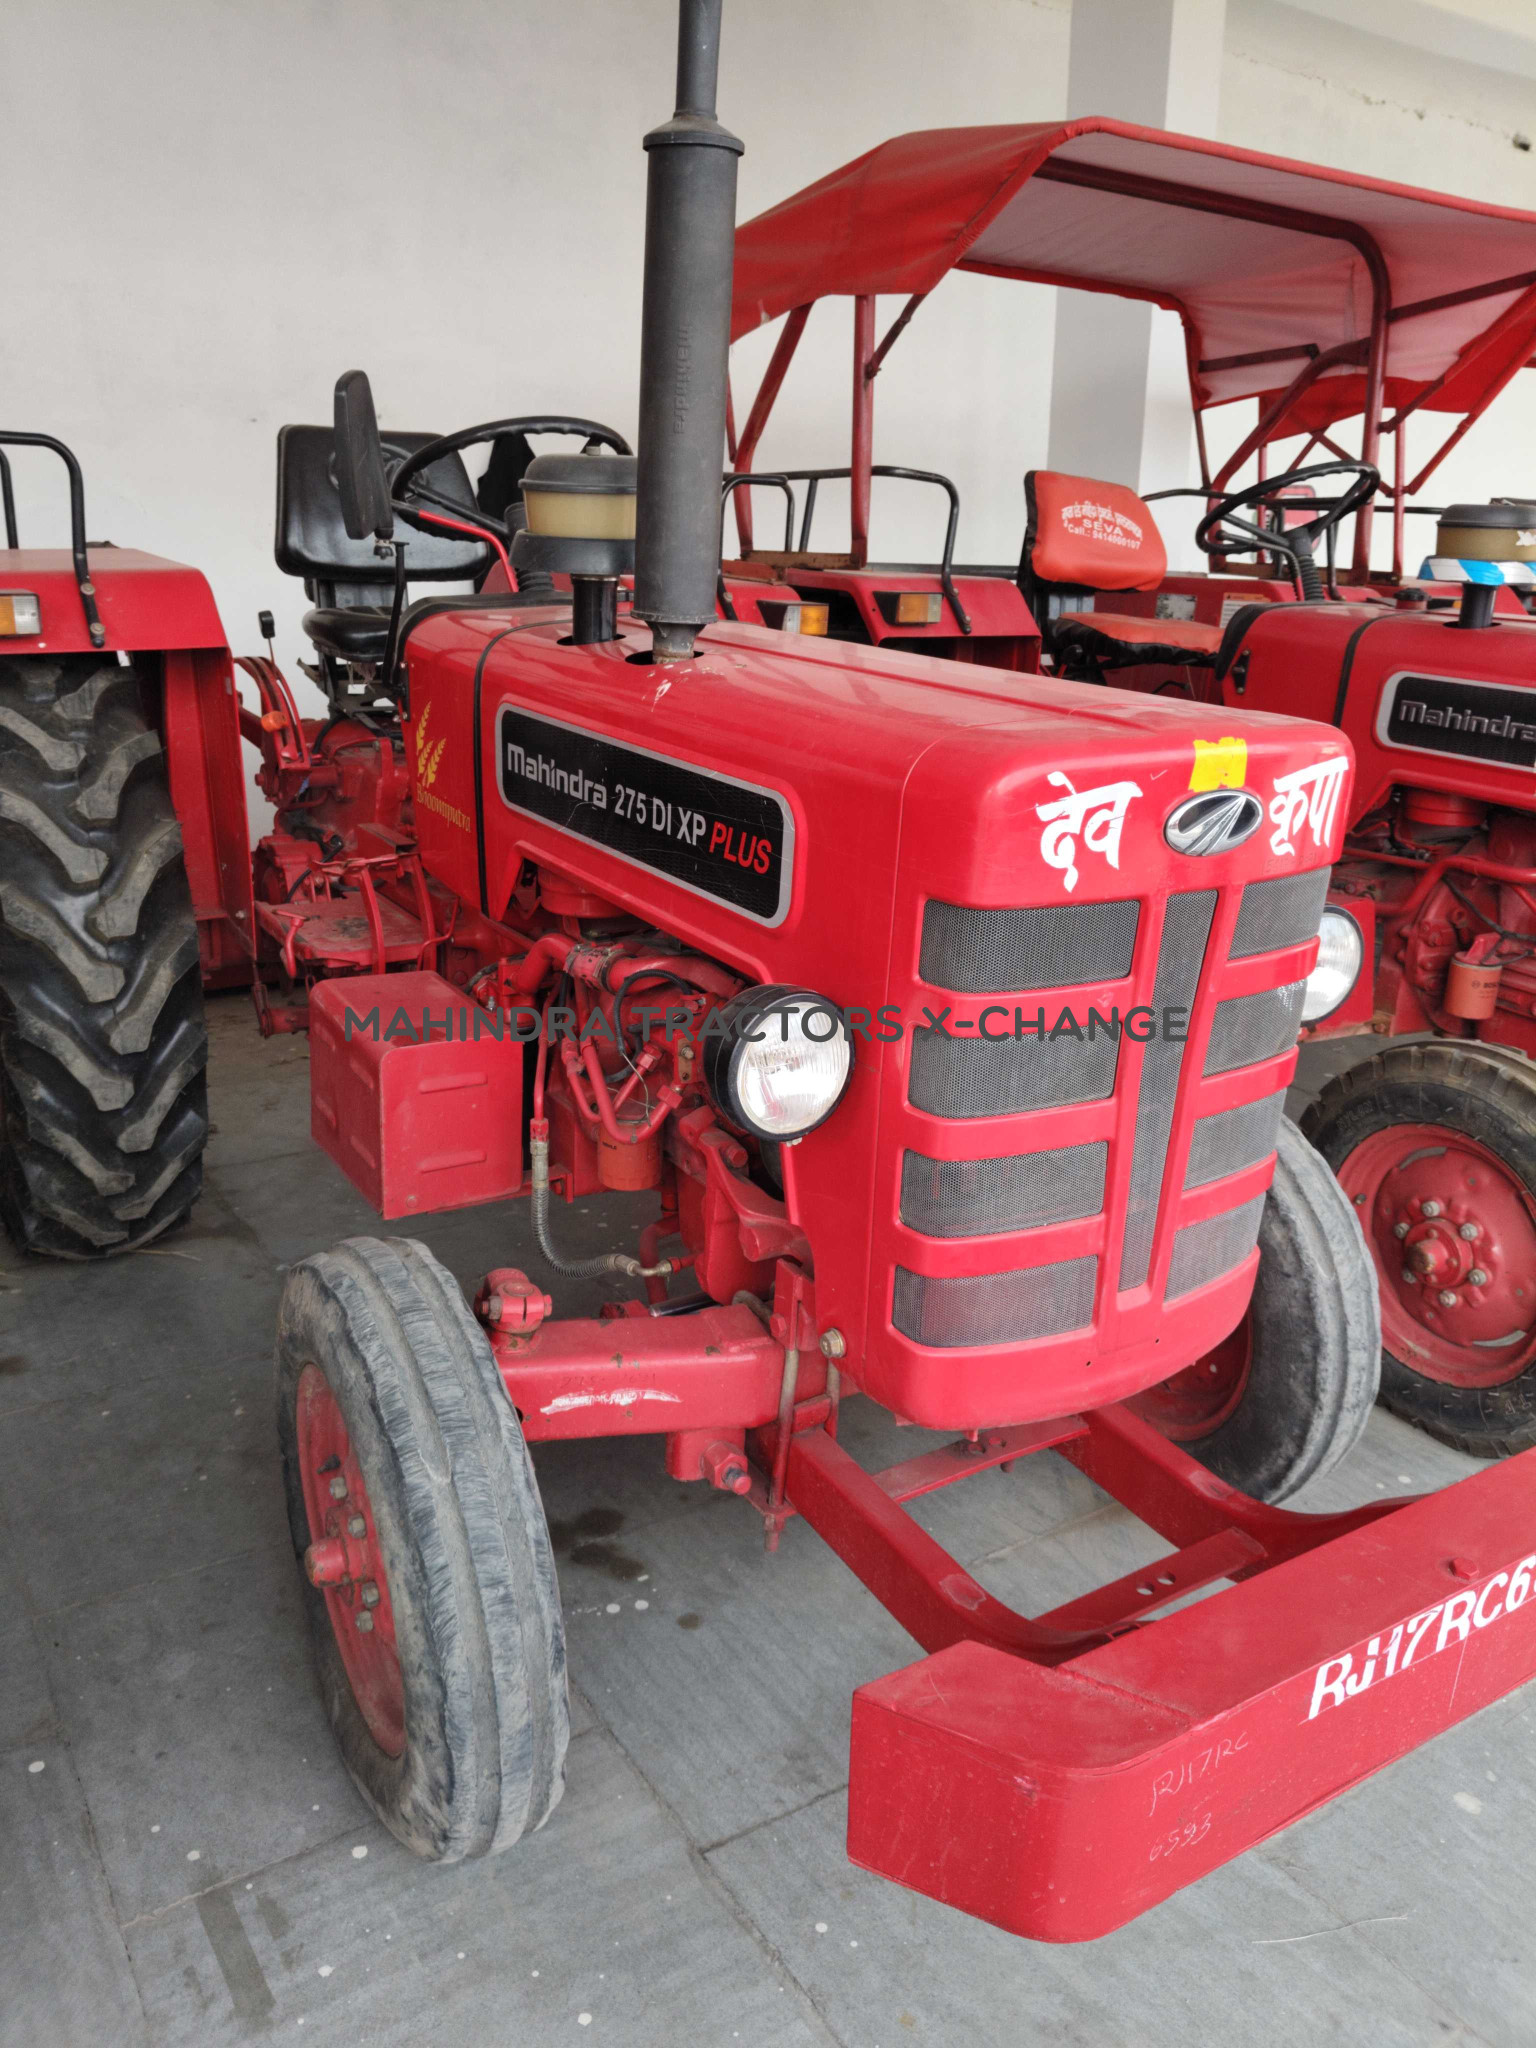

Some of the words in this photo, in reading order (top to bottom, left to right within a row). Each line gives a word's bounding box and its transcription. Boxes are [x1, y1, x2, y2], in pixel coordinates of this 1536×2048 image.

[1083, 518, 1123, 537] SEVA
[614, 784, 647, 825] 275
[652, 797, 672, 836] DI
[676, 806, 707, 847] XP
[709, 821, 772, 874] PLUS
[1036, 771, 1143, 893] देव
[1308, 1554, 1536, 1720] RJ17RC6
